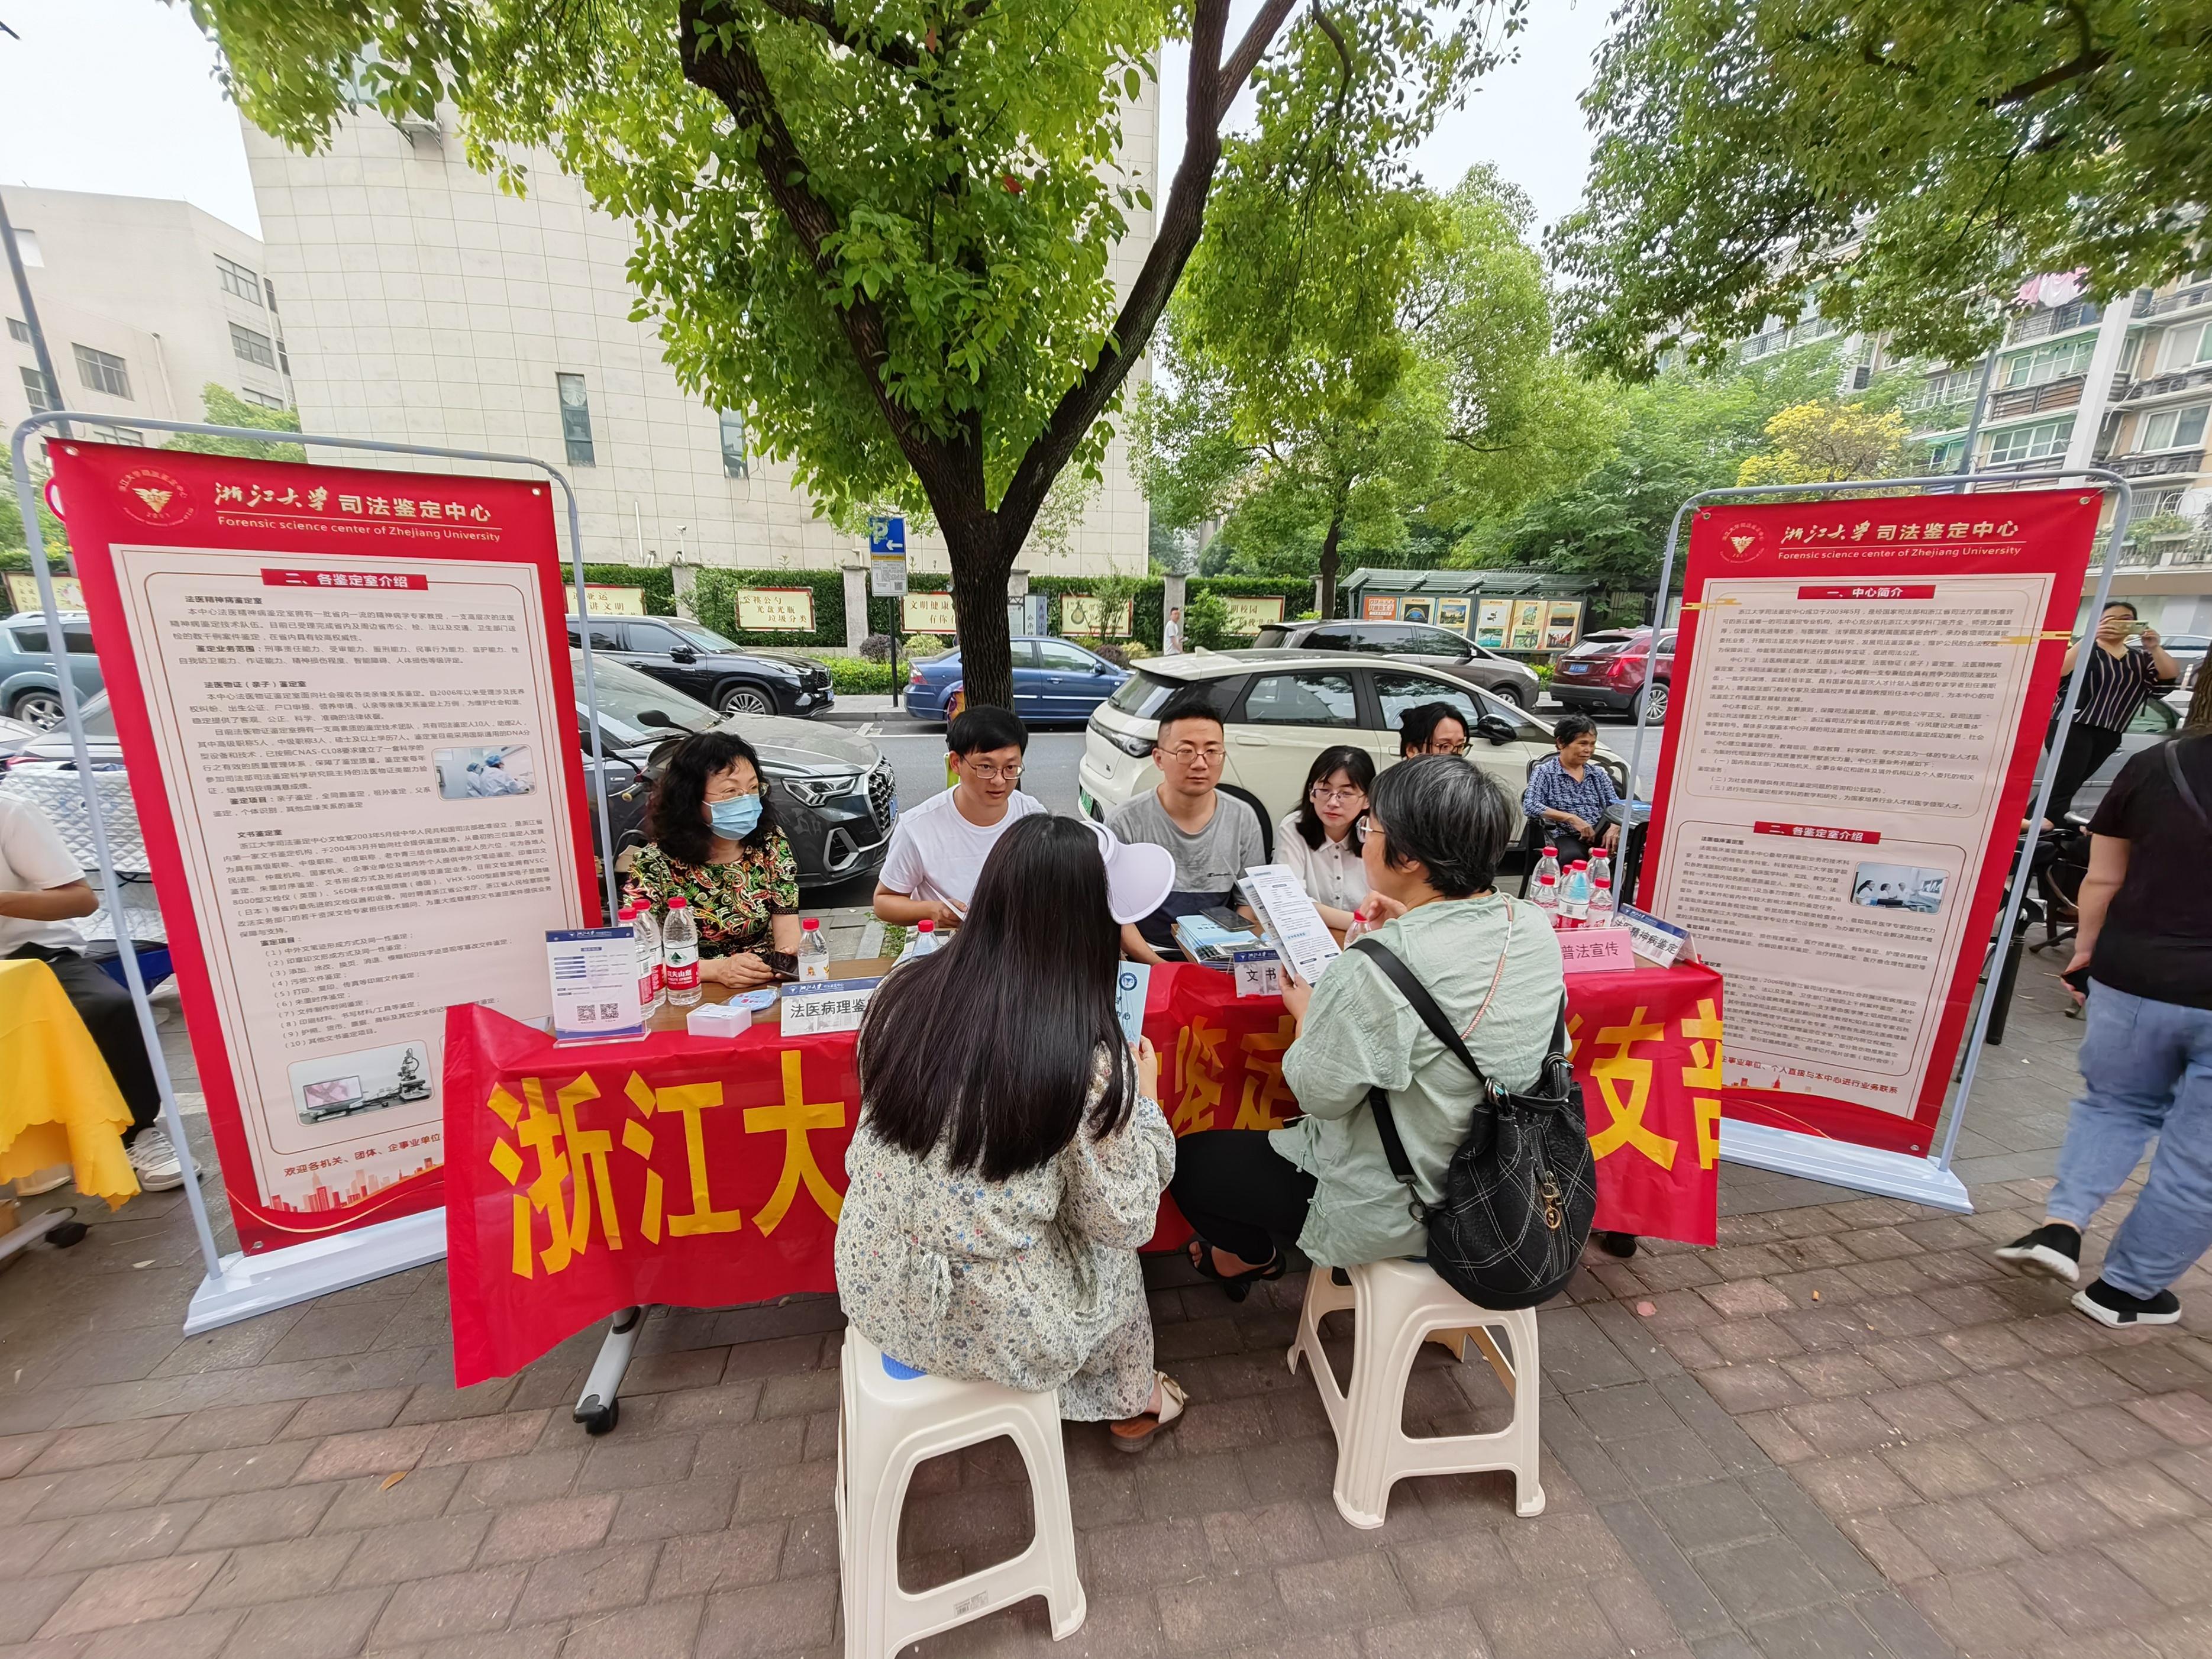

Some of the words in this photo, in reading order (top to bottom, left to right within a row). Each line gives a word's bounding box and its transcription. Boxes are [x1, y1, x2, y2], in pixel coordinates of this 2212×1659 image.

[214, 482, 328, 511] 浙江大学
[338, 494, 492, 522] 司法鉴定中心
[218, 516, 276, 529] Forensic
[279, 520, 328, 532] science
[331, 524, 370, 535] center
[373, 525, 386, 535] of
[389, 527, 441, 540] Zhejiang
[444, 530, 500, 543] University
[1780, 521, 1871, 544] 浙江大学
[1877, 519, 2019, 541] 司法鉴定中心
[1778, 550, 1819, 560] Forensic
[1822, 549, 1859, 559] science
[1861, 548, 1895, 559] center
[1897, 547, 1910, 557] of
[1911, 547, 1960, 559] Zhejiang
[1962, 545, 2022, 559] University
[285, 572, 408, 588] 二、各鉴定室介绍
[185, 595, 263, 605] 法医精神病鉴定室
[1827, 586, 1903, 598] 一、中心简介
[910, 601, 949, 610] 文明健康
[1769, 824, 1864, 841] 二、各鉴定室介绍
[1561, 941, 1619, 960] 普法宣传
[1247, 967, 1277, 982] 文书
[790, 998, 868, 1019] 法医病理鉴
[486, 1050, 845, 1280] 浙江大
